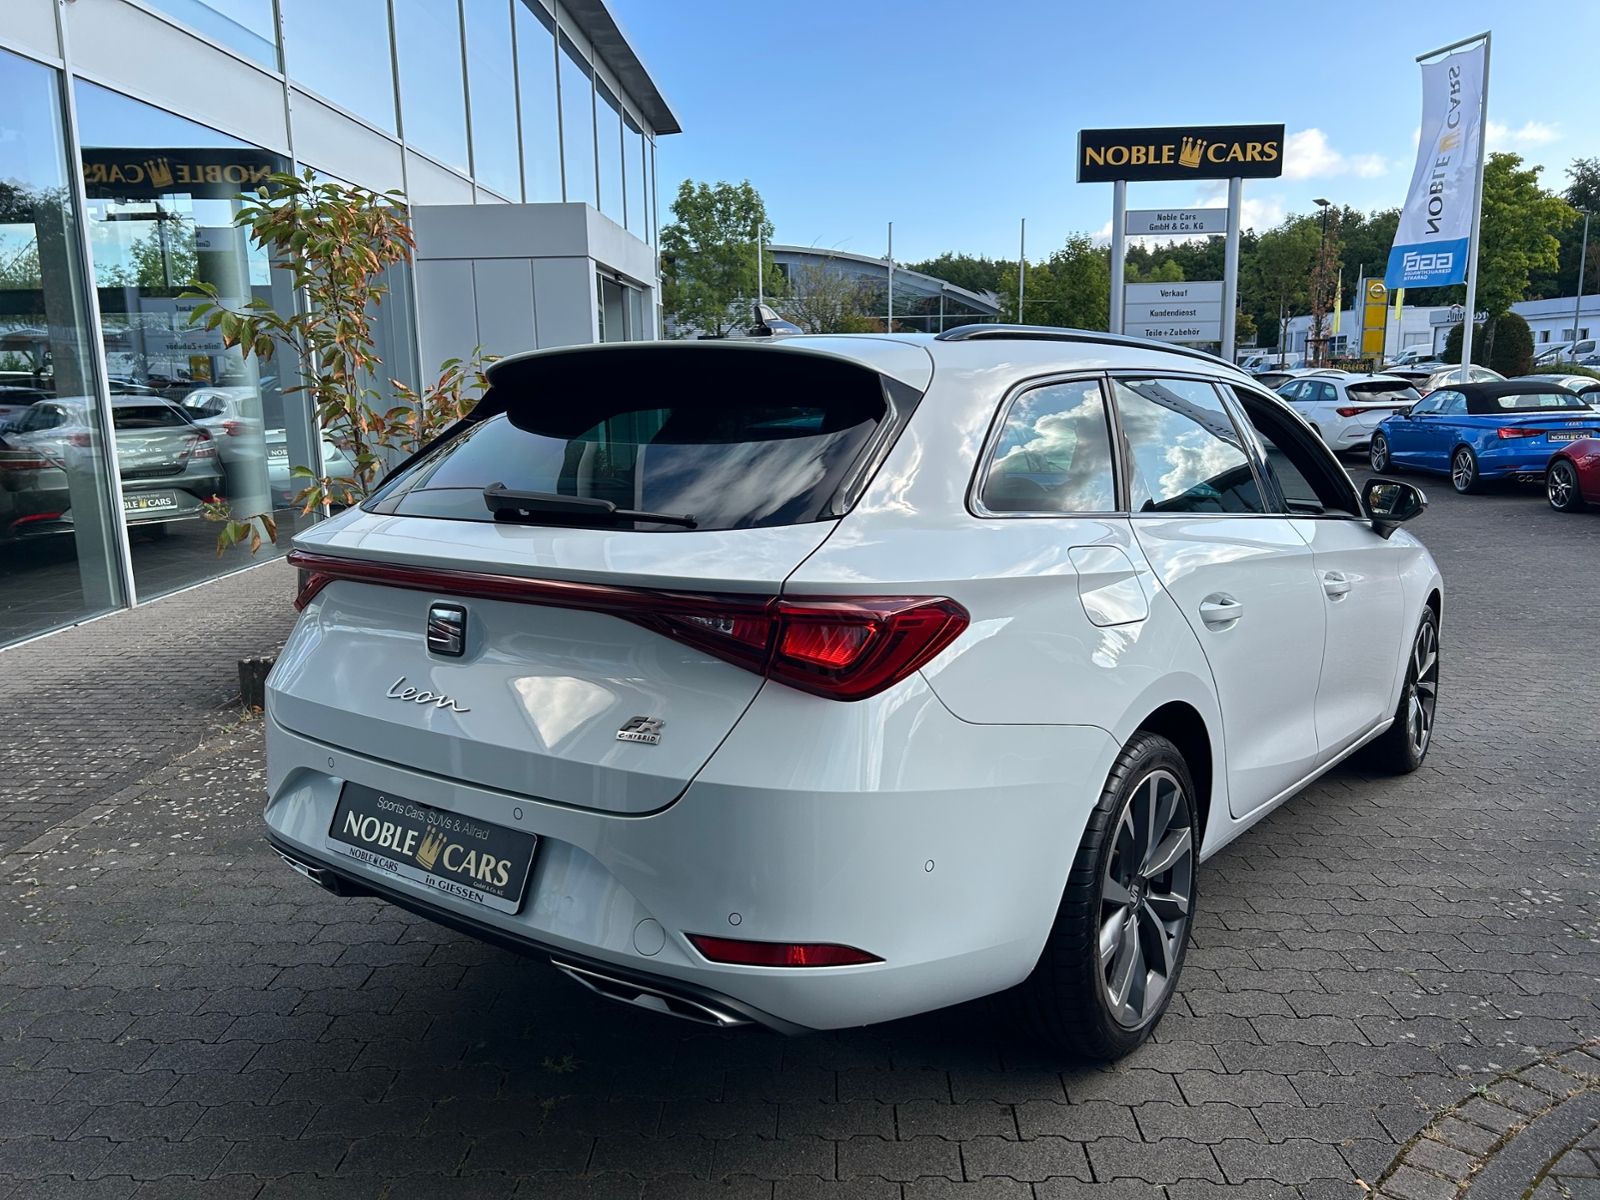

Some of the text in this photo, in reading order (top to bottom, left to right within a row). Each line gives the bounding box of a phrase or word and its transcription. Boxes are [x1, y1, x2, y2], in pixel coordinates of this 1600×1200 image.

[1085, 141, 1278, 166] NOBLE CARS
[1149, 223, 1170, 231] GmbH
[1180, 222, 1191, 230] Co.
[1193, 222, 1204, 230] KG
[1160, 289, 1188, 297] Verkauf
[1150, 309, 1196, 317] Kundendienst
[147, 497, 171, 507] CARS
[386, 676, 471, 712] Leon
[377, 796, 404, 814] Sports
[427, 812, 452, 829] SUVs
[453, 819, 461, 832] &
[462, 822, 490, 840] Allrad
[343, 810, 512, 887] NOBLE CARS
[349, 847, 399, 872] NOBLE CARS
[425, 875, 484, 902] in GIESSEN
